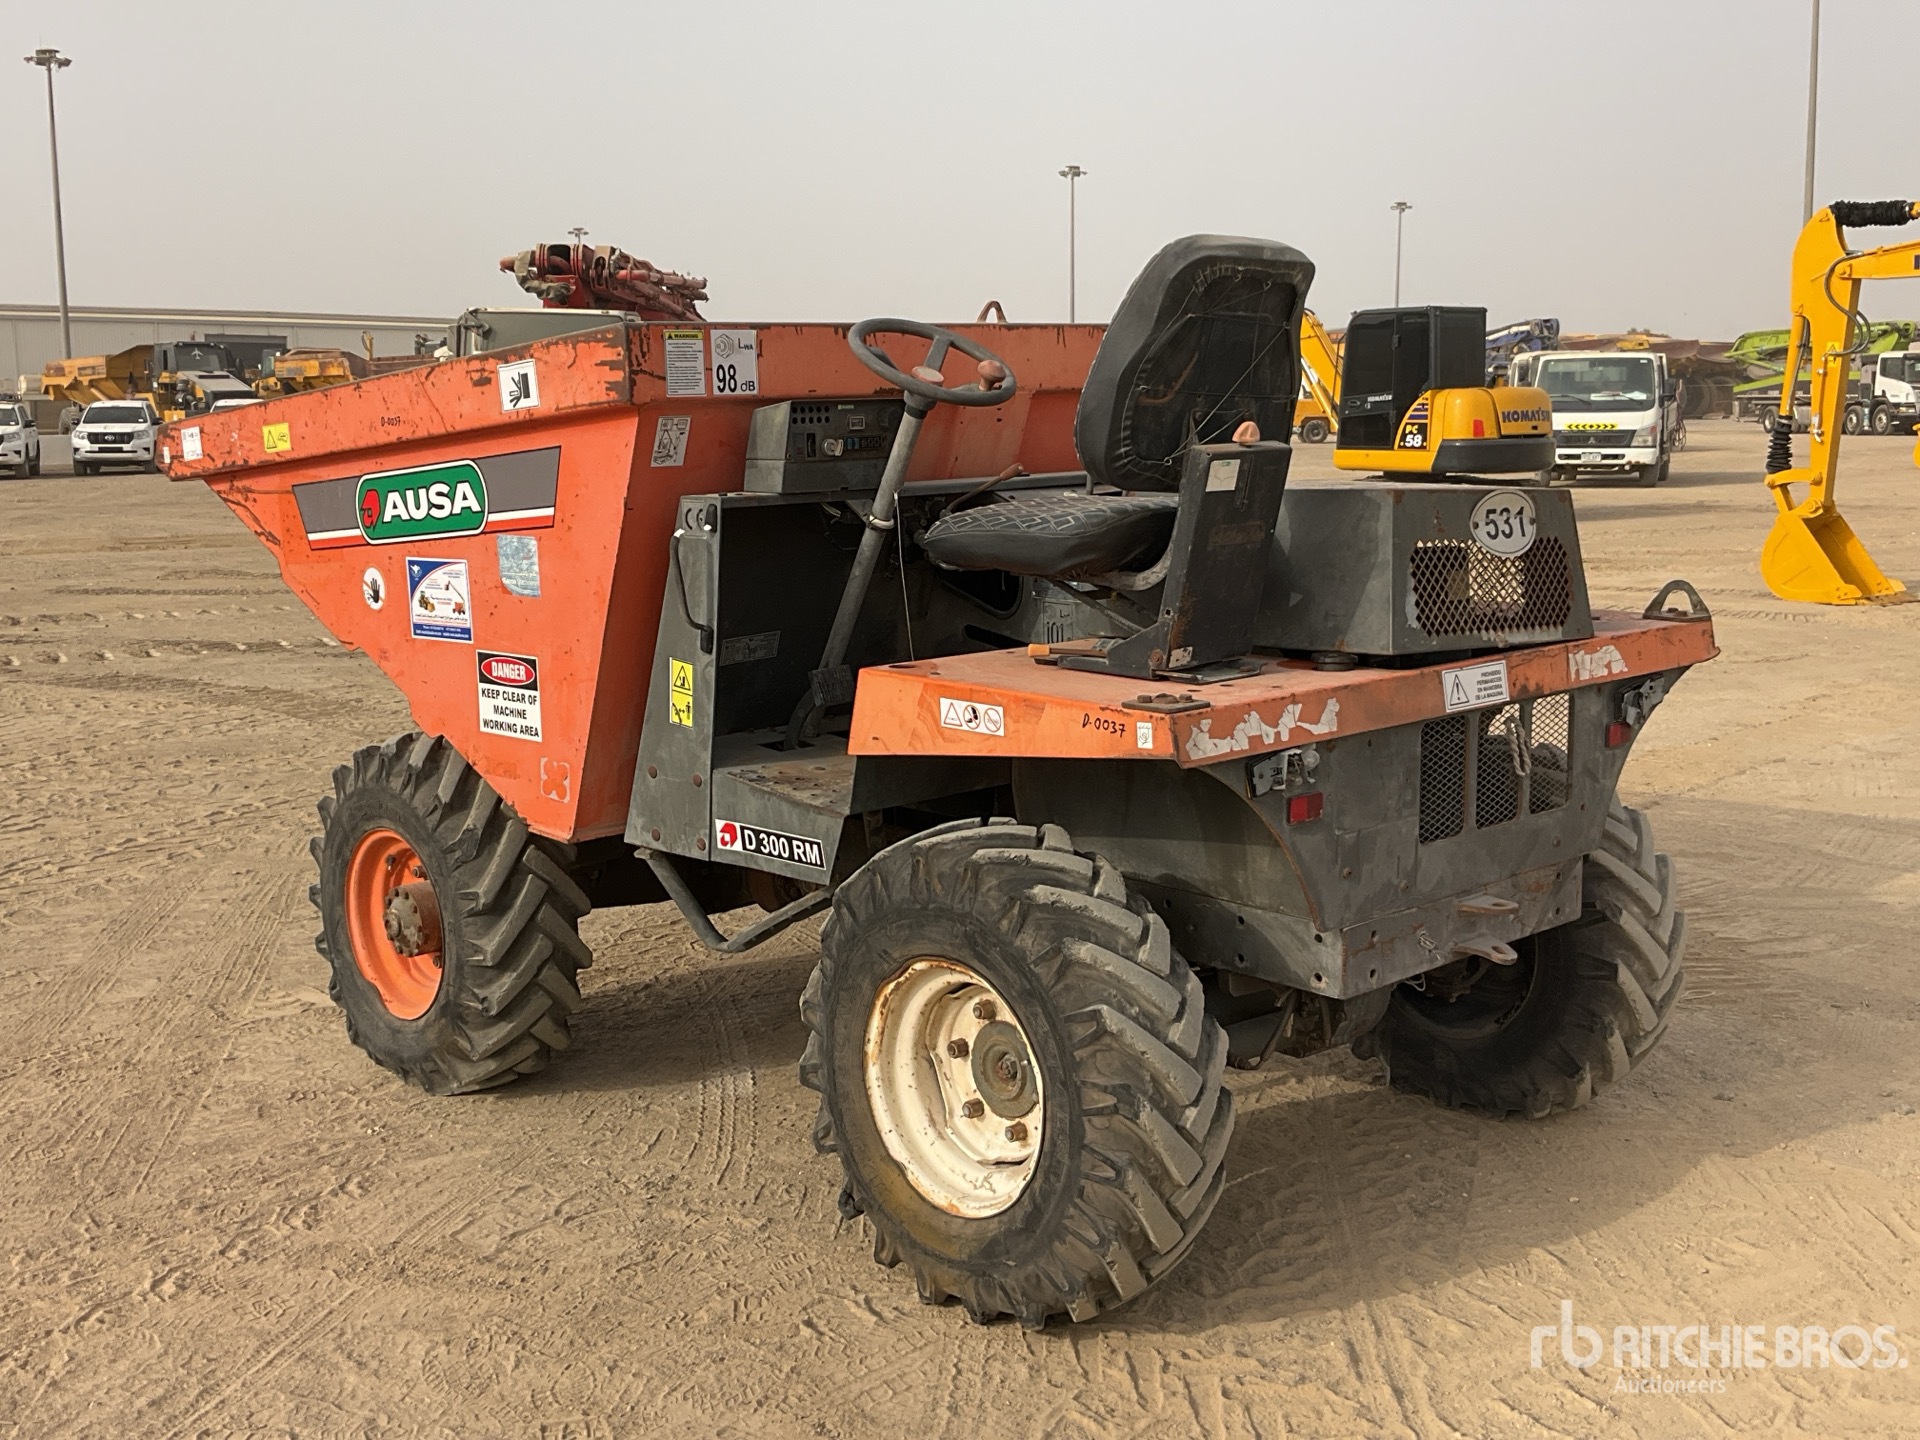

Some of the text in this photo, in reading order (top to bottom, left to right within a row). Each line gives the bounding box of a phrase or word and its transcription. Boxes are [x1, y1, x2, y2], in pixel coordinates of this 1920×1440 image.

[716, 363, 737, 393] 98
[740, 380, 756, 392] dB
[1405, 424, 1419, 434] PC
[1404, 434, 1423, 447] 58
[381, 480, 482, 525] AUSA
[1484, 506, 1526, 541] 531
[490, 661, 527, 681] DANGER
[481, 687, 537, 705] KEEP CLEAR OF
[493, 704, 527, 720] MACHINE
[483, 718, 540, 738] WORKING AREA
[743, 829, 821, 866] D 300 RM
